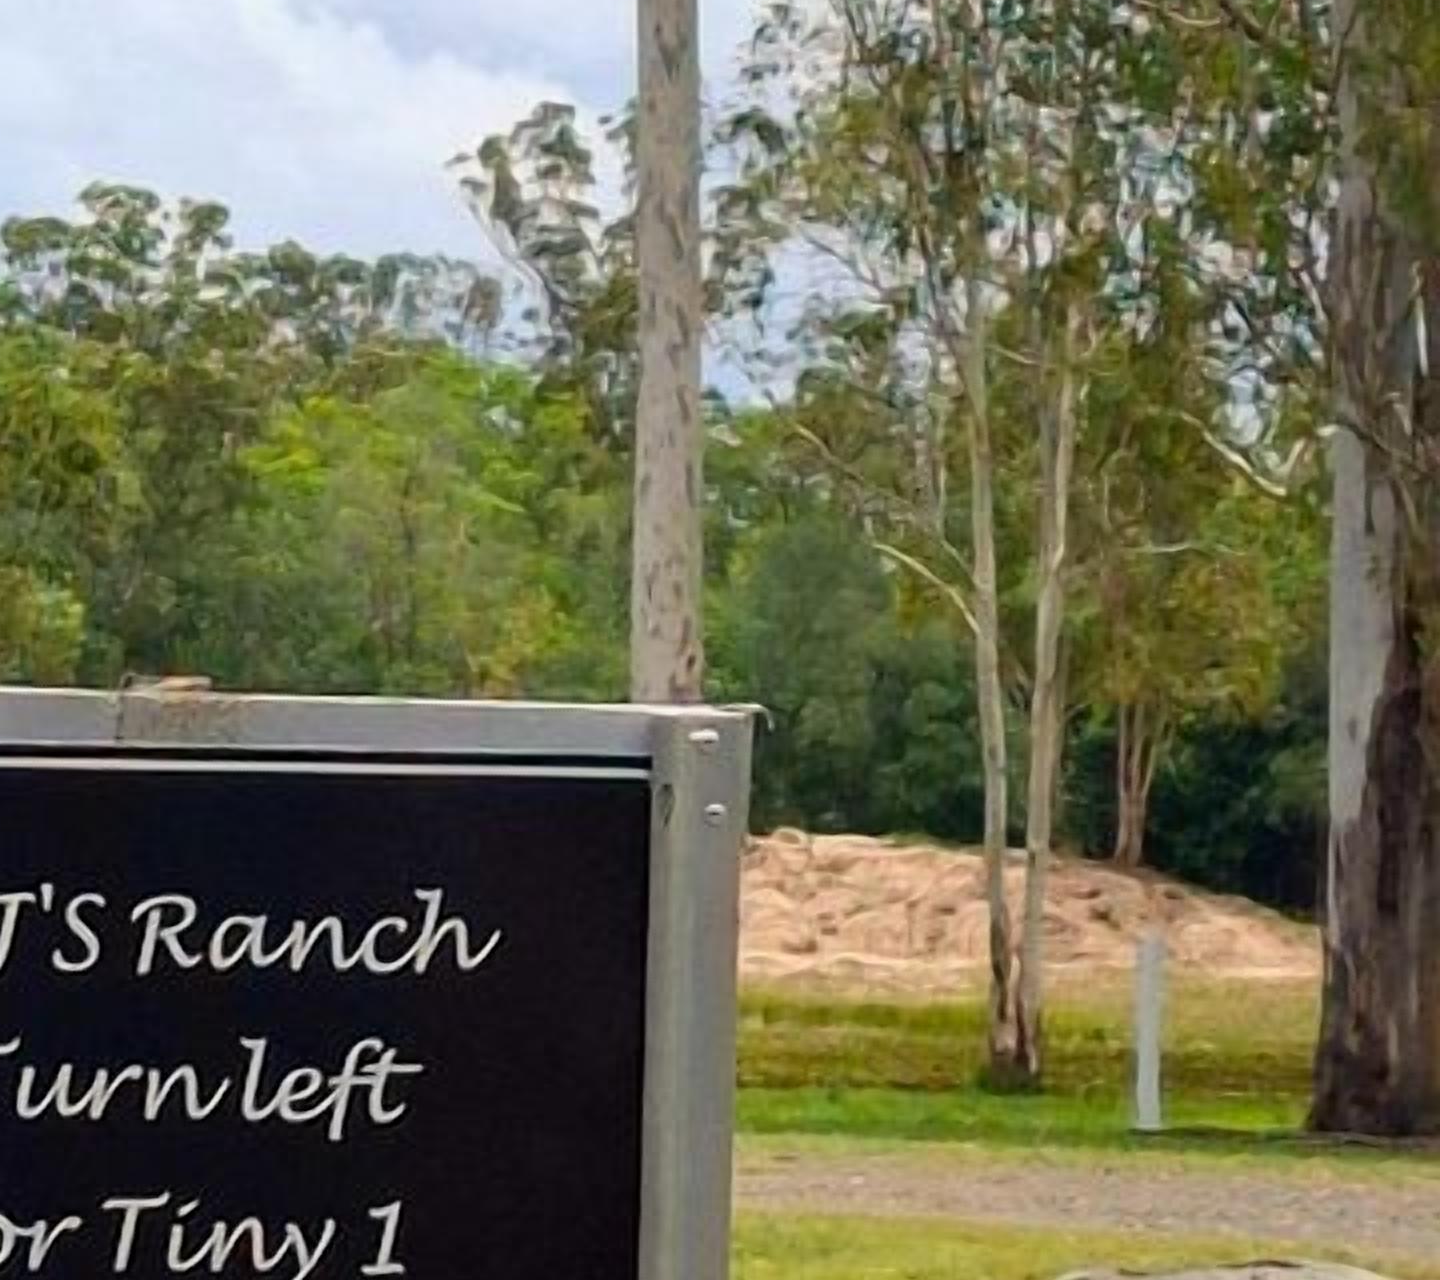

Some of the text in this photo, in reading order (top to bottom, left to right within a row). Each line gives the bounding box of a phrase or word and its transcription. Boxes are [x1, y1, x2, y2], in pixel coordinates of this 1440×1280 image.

[130, 887, 502, 974] Ranch
[239, 1036, 424, 1142] left
[360, 1200, 405, 1276] 1
